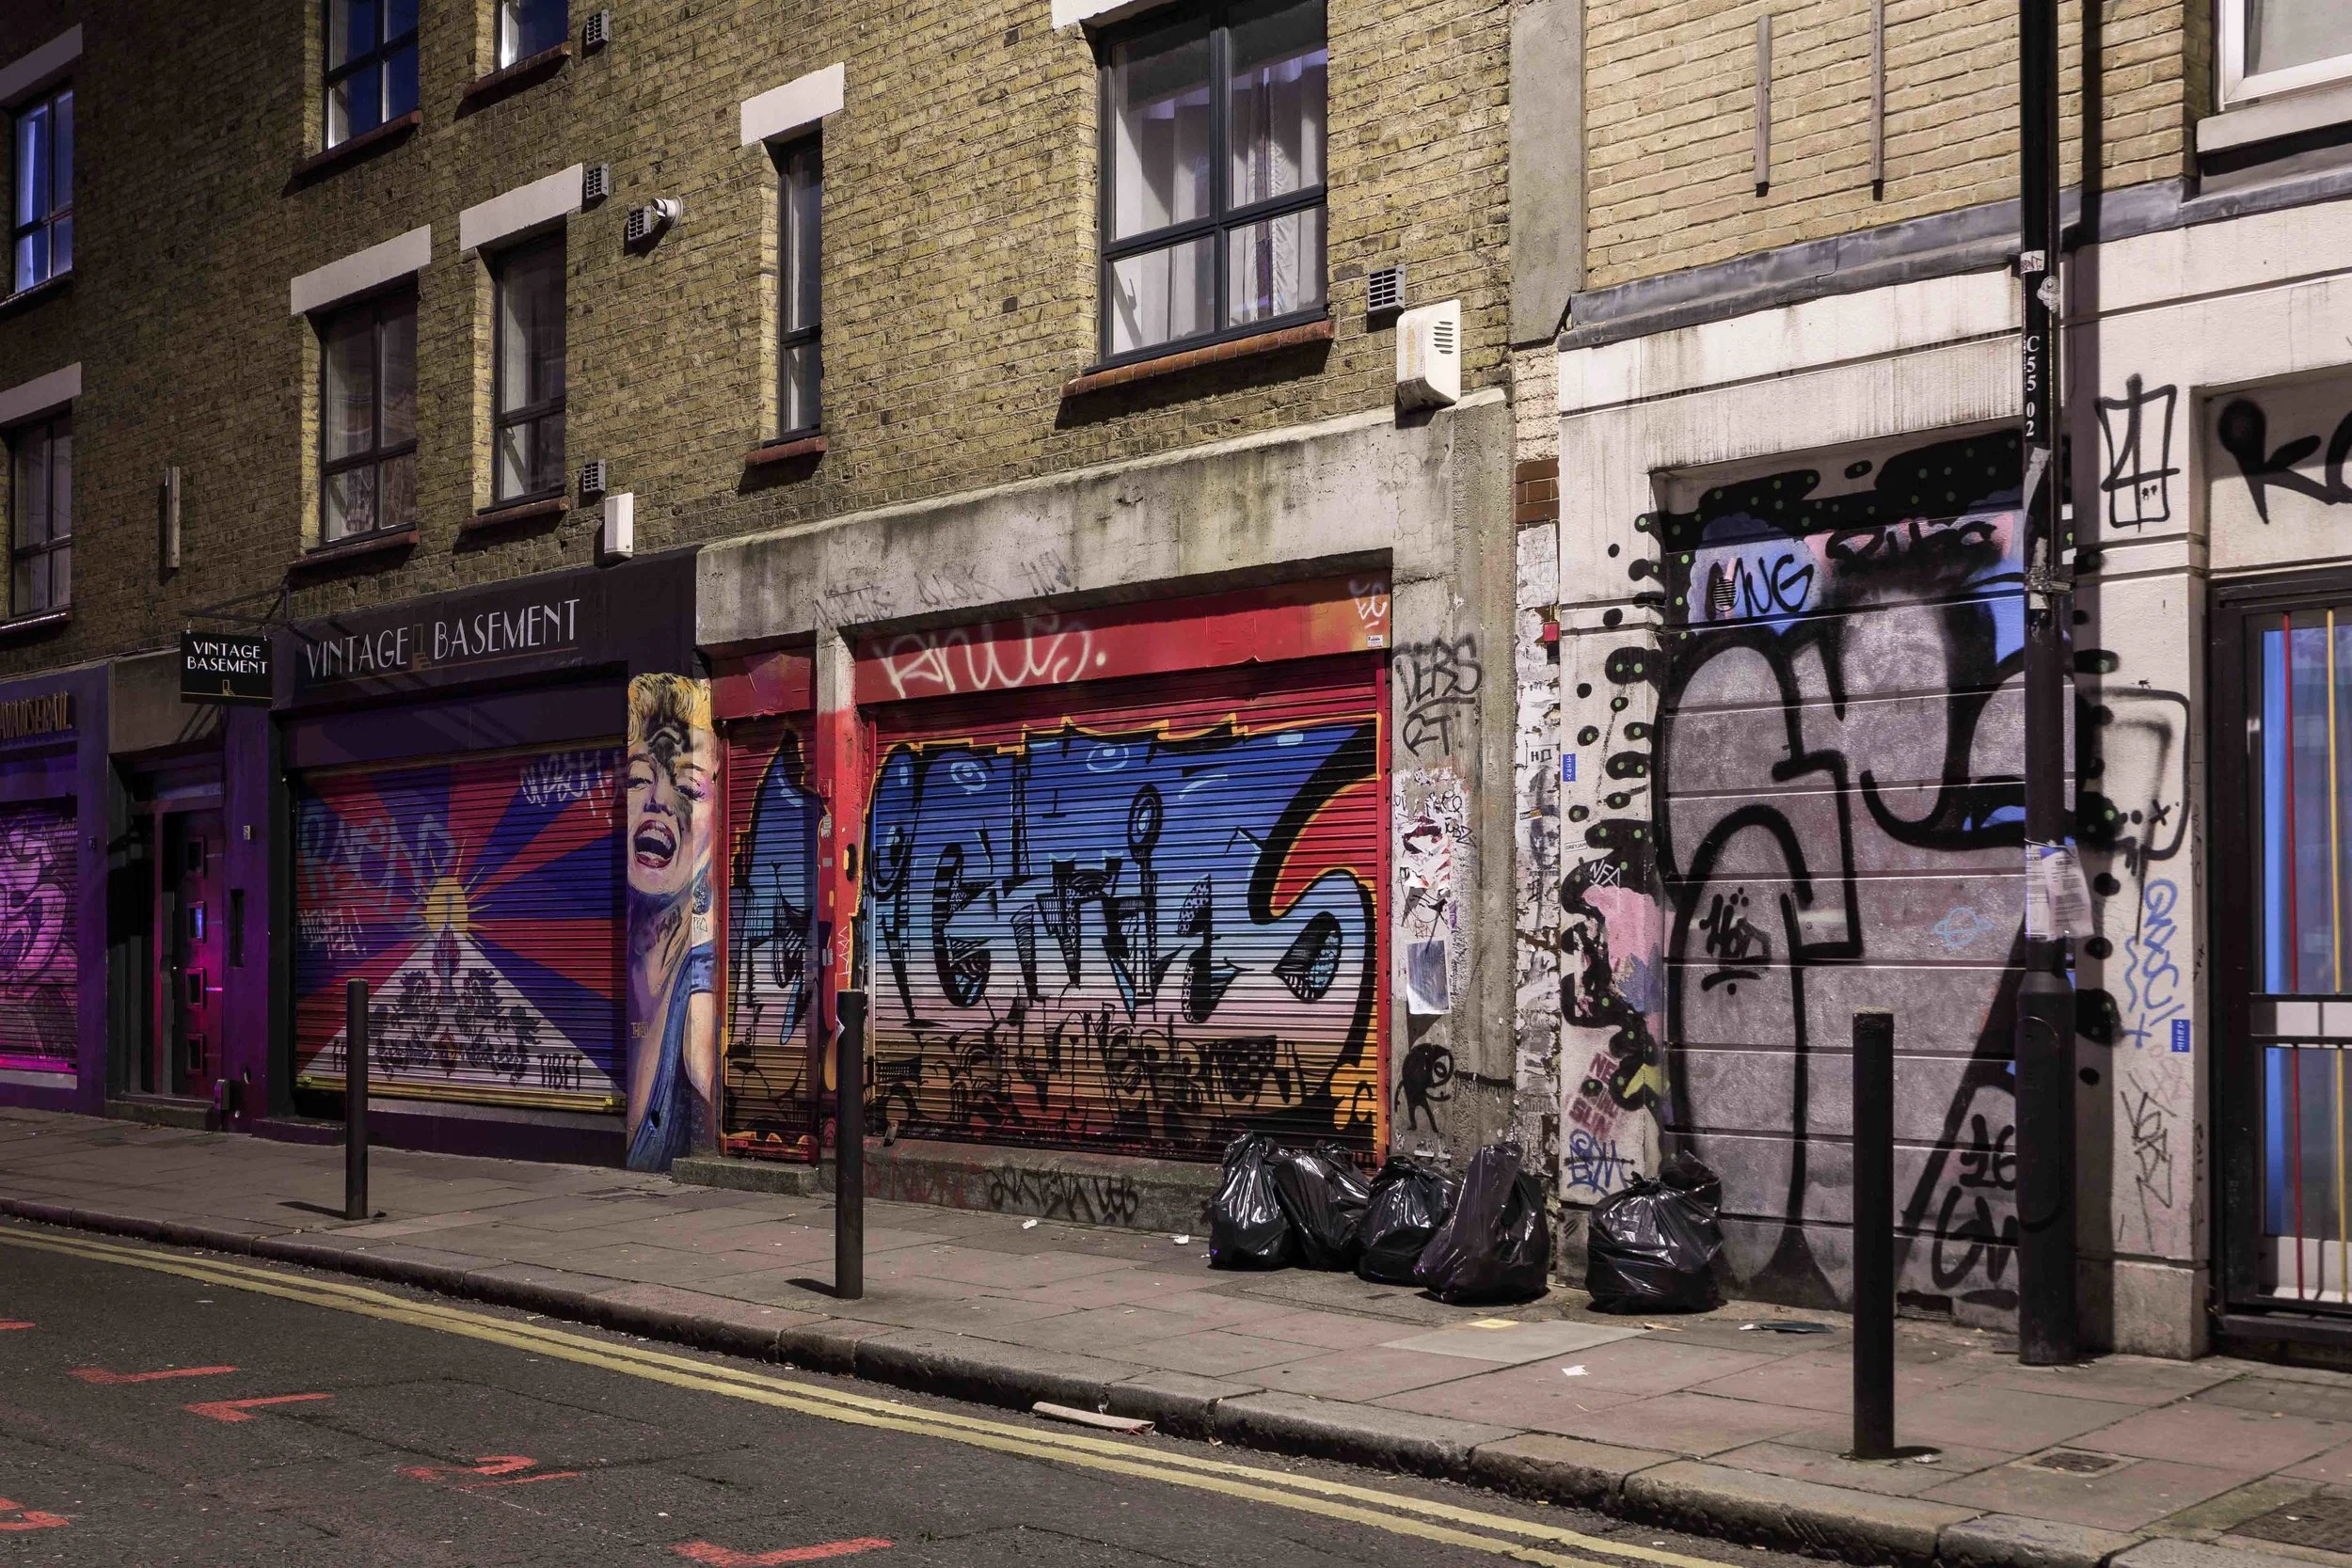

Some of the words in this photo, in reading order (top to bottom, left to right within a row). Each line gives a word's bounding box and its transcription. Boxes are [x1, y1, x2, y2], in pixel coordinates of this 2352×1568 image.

[193, 641, 262, 659] VINTAGE
[306, 626, 408, 678] VINTAGE
[434, 598, 580, 659] BASEMENT
[186, 656, 268, 675] BASEMENT
[536, 1053, 583, 1092] TIBET
